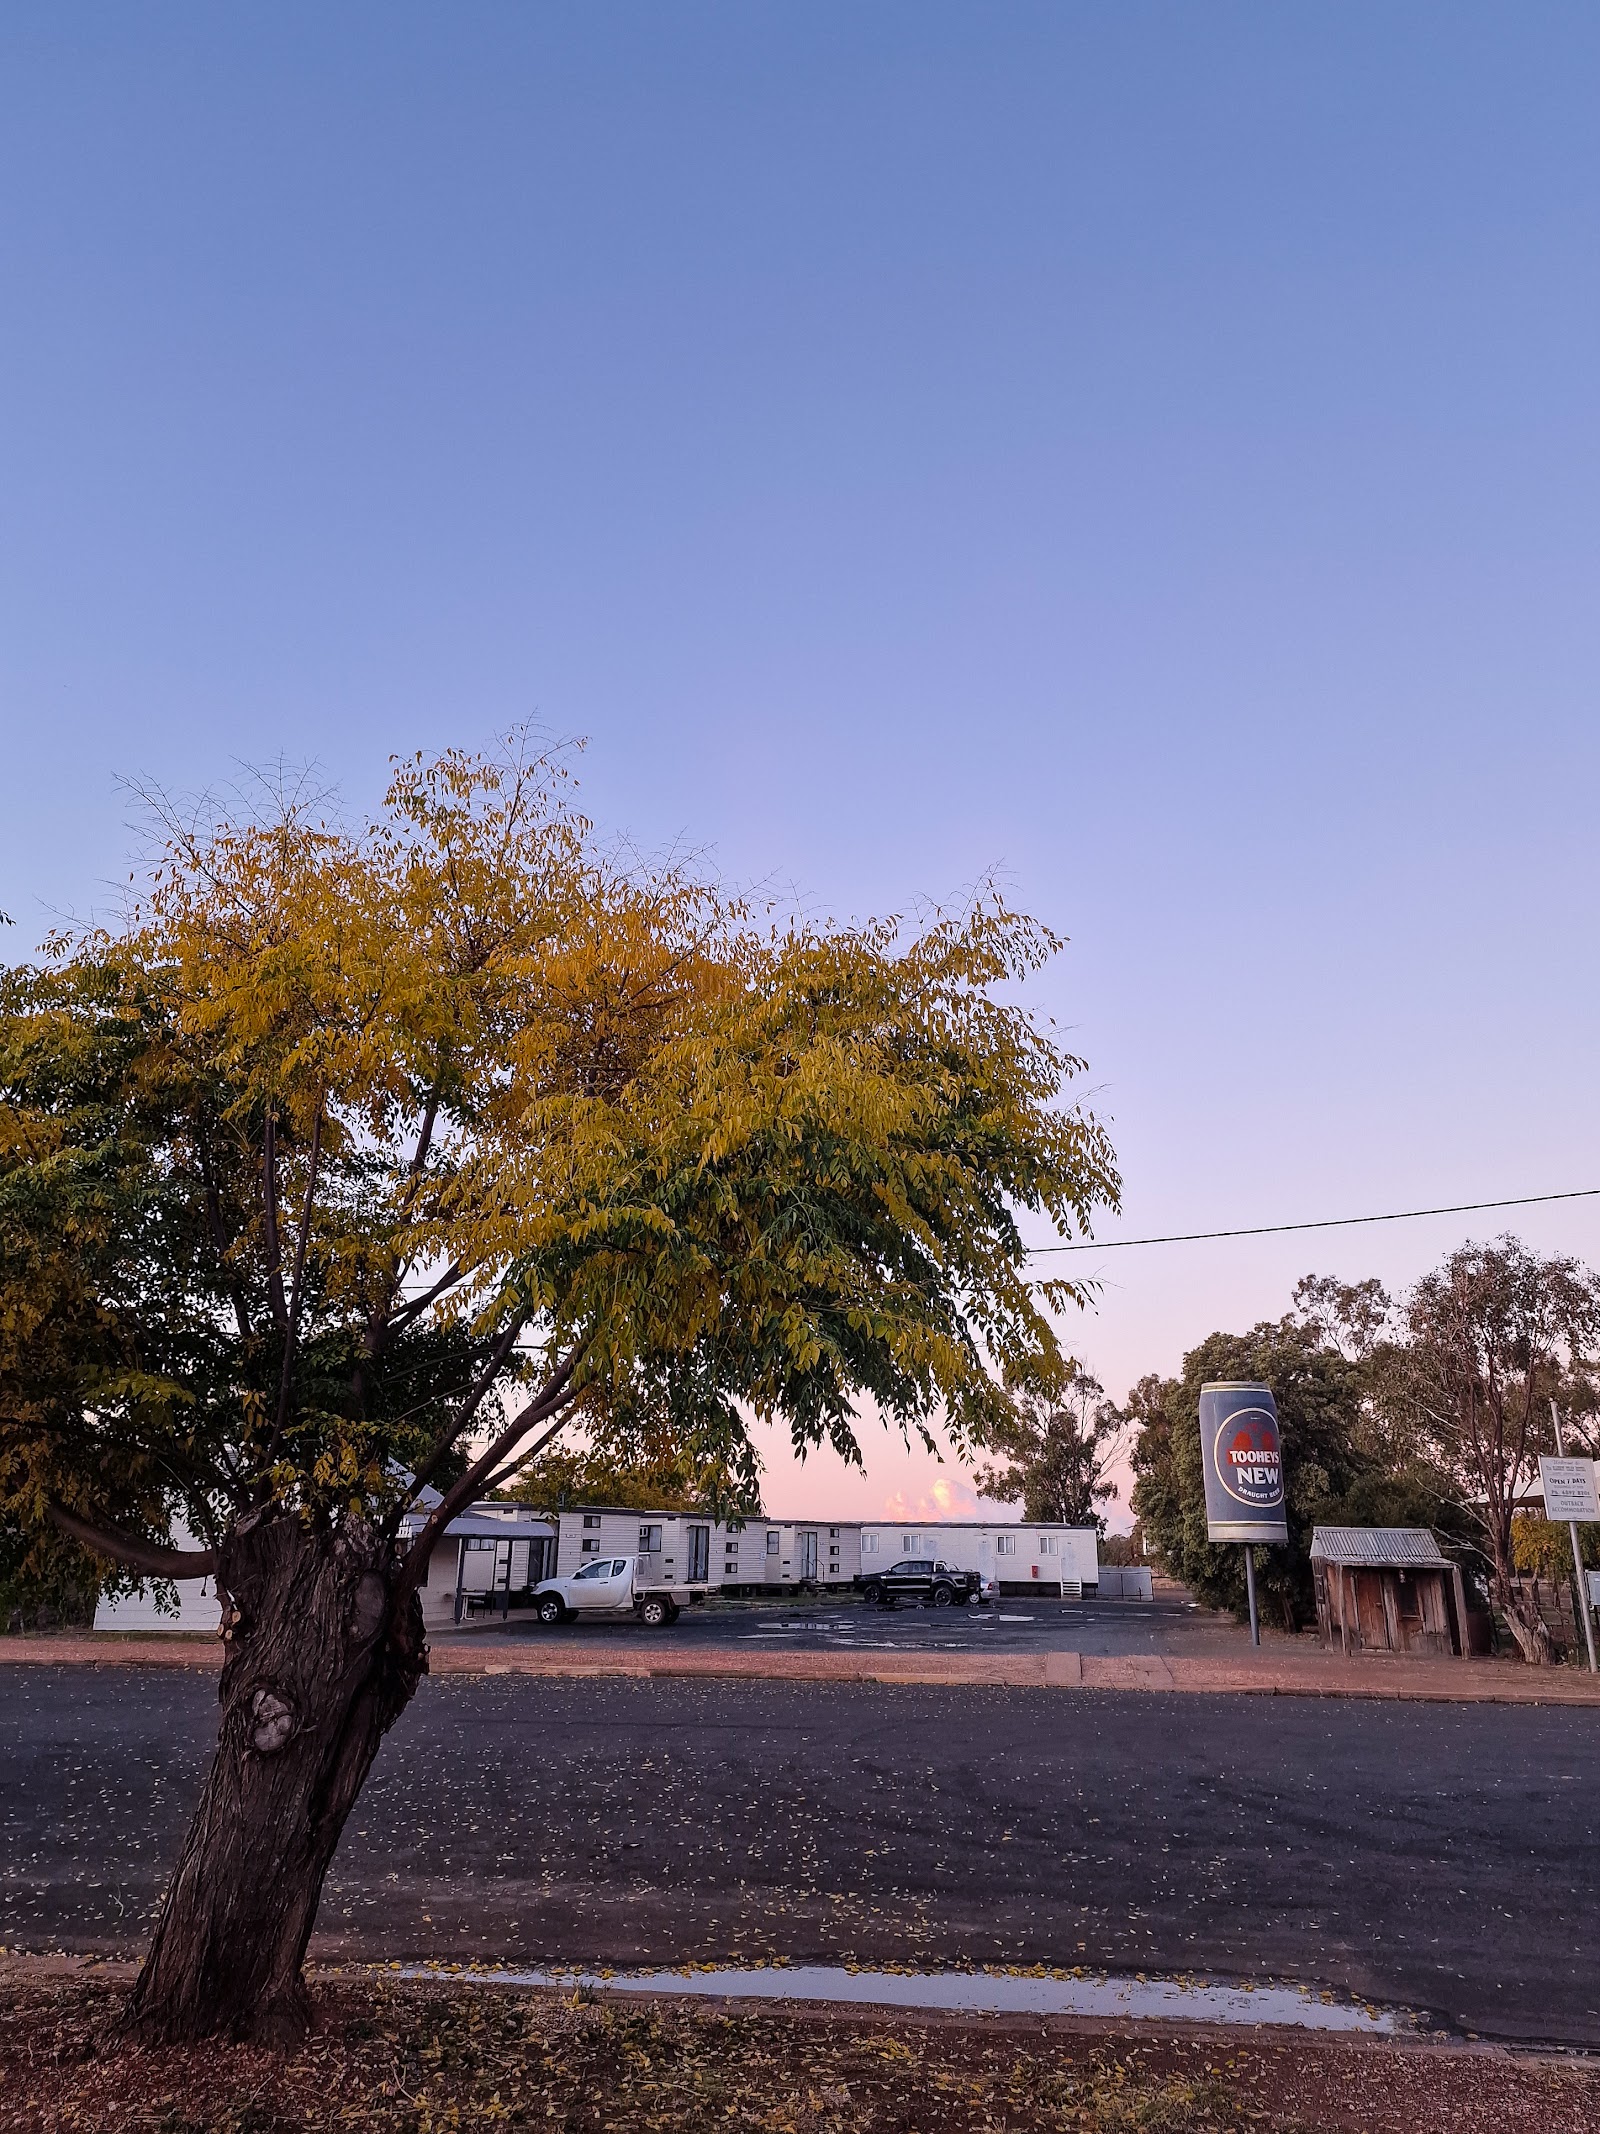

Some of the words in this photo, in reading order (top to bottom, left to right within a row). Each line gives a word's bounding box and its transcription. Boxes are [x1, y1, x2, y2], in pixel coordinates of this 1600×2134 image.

[1230, 1450, 1279, 1463] TOOHEYS
[1236, 1467, 1279, 1485] NEW
[1237, 1486, 1268, 1498] DRAUGHT
